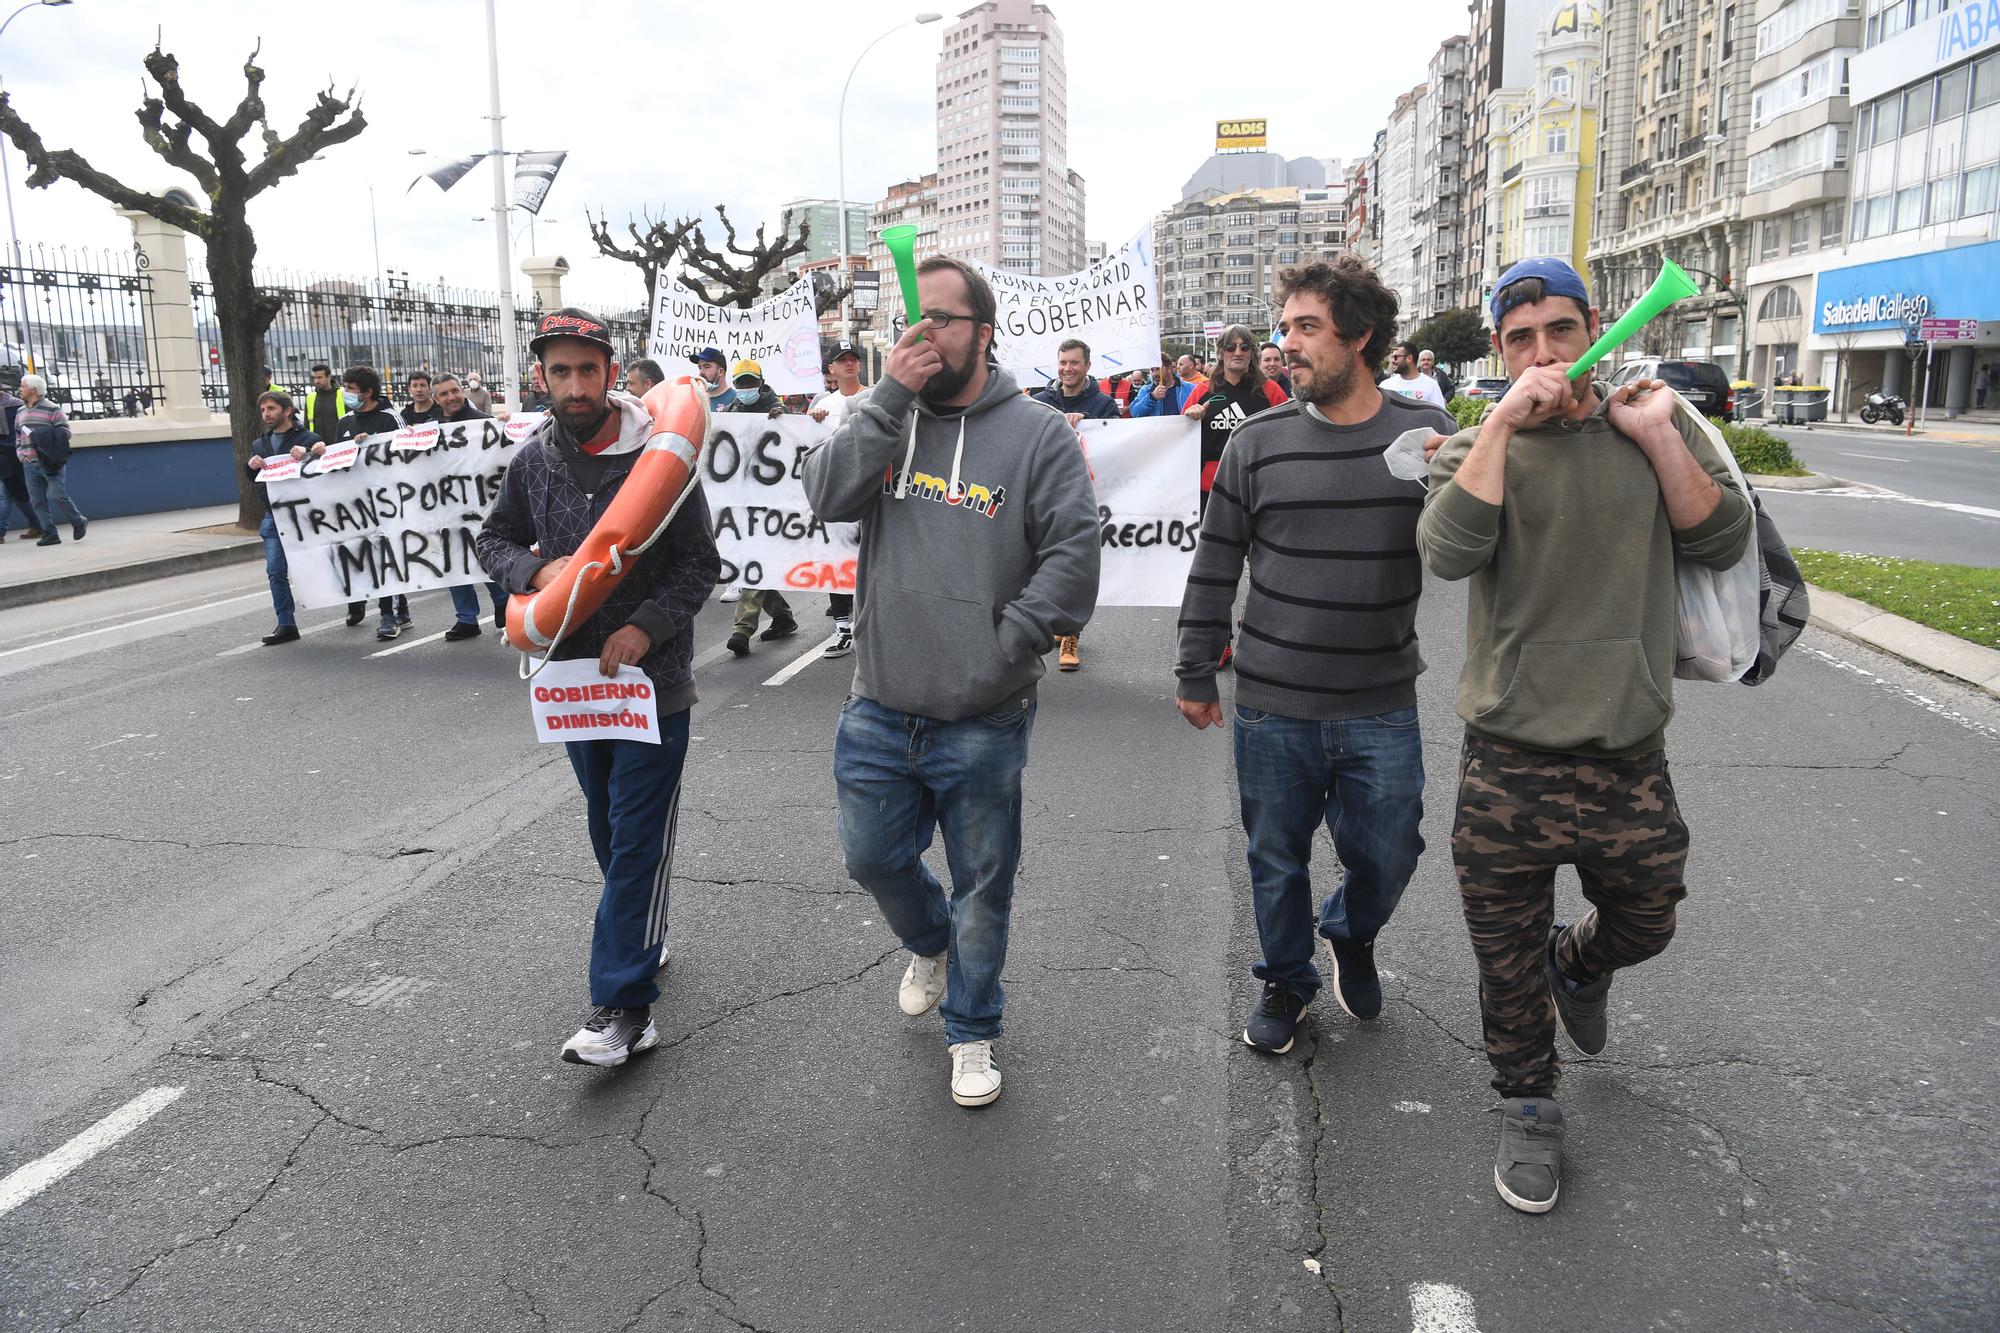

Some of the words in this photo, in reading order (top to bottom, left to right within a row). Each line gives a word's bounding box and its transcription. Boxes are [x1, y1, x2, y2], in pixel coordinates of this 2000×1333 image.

[1219, 122, 1264, 135] GADIS
[659, 274, 669, 290] O
[990, 272, 1049, 293] RUINA
[1055, 277, 1079, 292] DO
[1031, 295, 1053, 307] EN
[1063, 262, 1131, 301] MADRID
[660, 297, 731, 323] FUNDEN
[762, 295, 813, 321] FLOTA
[656, 320, 666, 339] E
[673, 324, 718, 345] UNHA
[727, 330, 764, 346] MAN
[750, 344, 782, 361] BOTA
[1210, 418, 1238, 430] adid
[272, 466, 507, 541] TRANSPORTIS
[784, 560, 857, 589] GAS
[534, 683, 651, 703] GOBIERNO
[546, 708, 649, 730] DIMISIÓN
